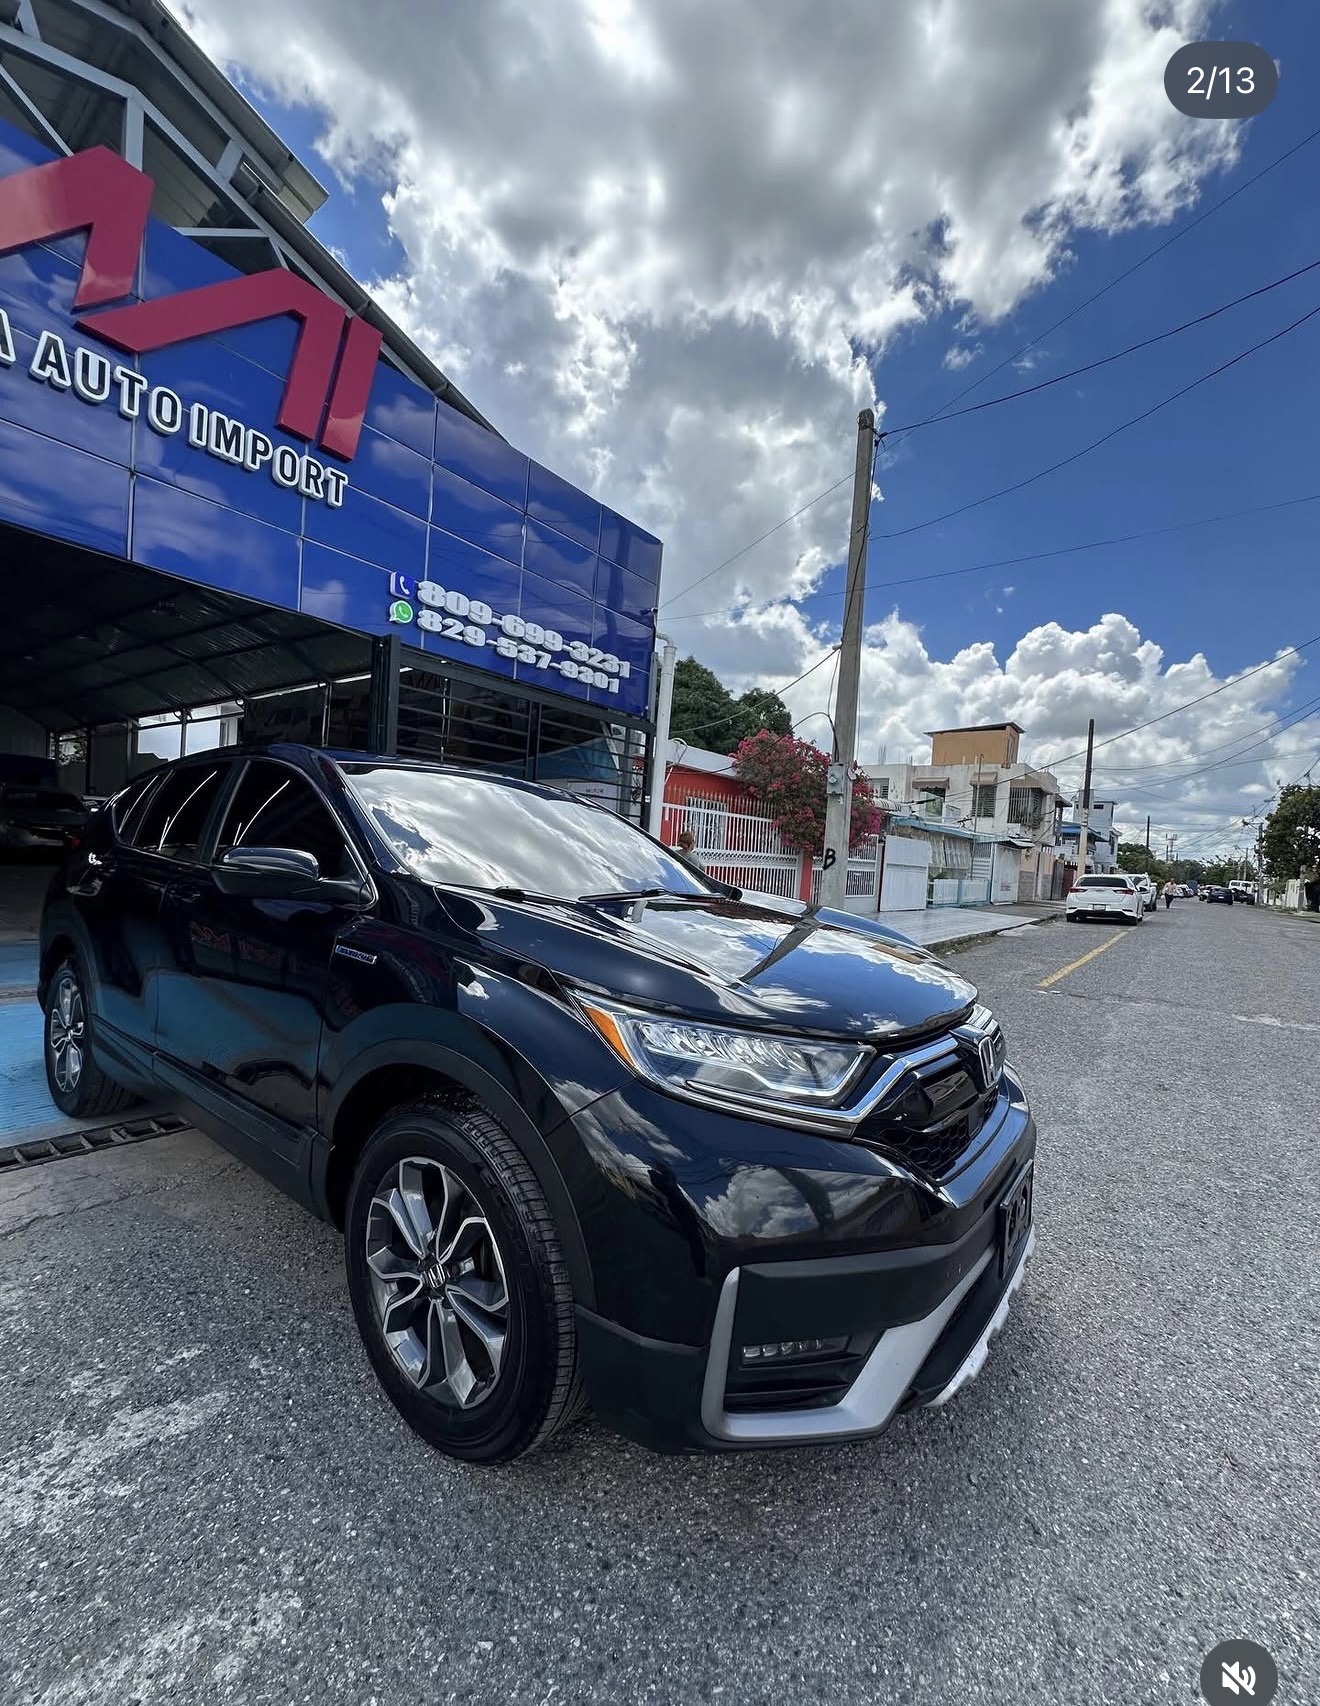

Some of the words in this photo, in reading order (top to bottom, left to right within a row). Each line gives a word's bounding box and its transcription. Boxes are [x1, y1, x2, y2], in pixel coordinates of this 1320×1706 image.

[29, 331, 183, 435] AUTO
[189, 403, 349, 507] IMPORT
[417, 581, 631, 679] 809-699-3231
[417, 610, 620, 694] 829-537-9301
[823, 847, 837, 870] B
